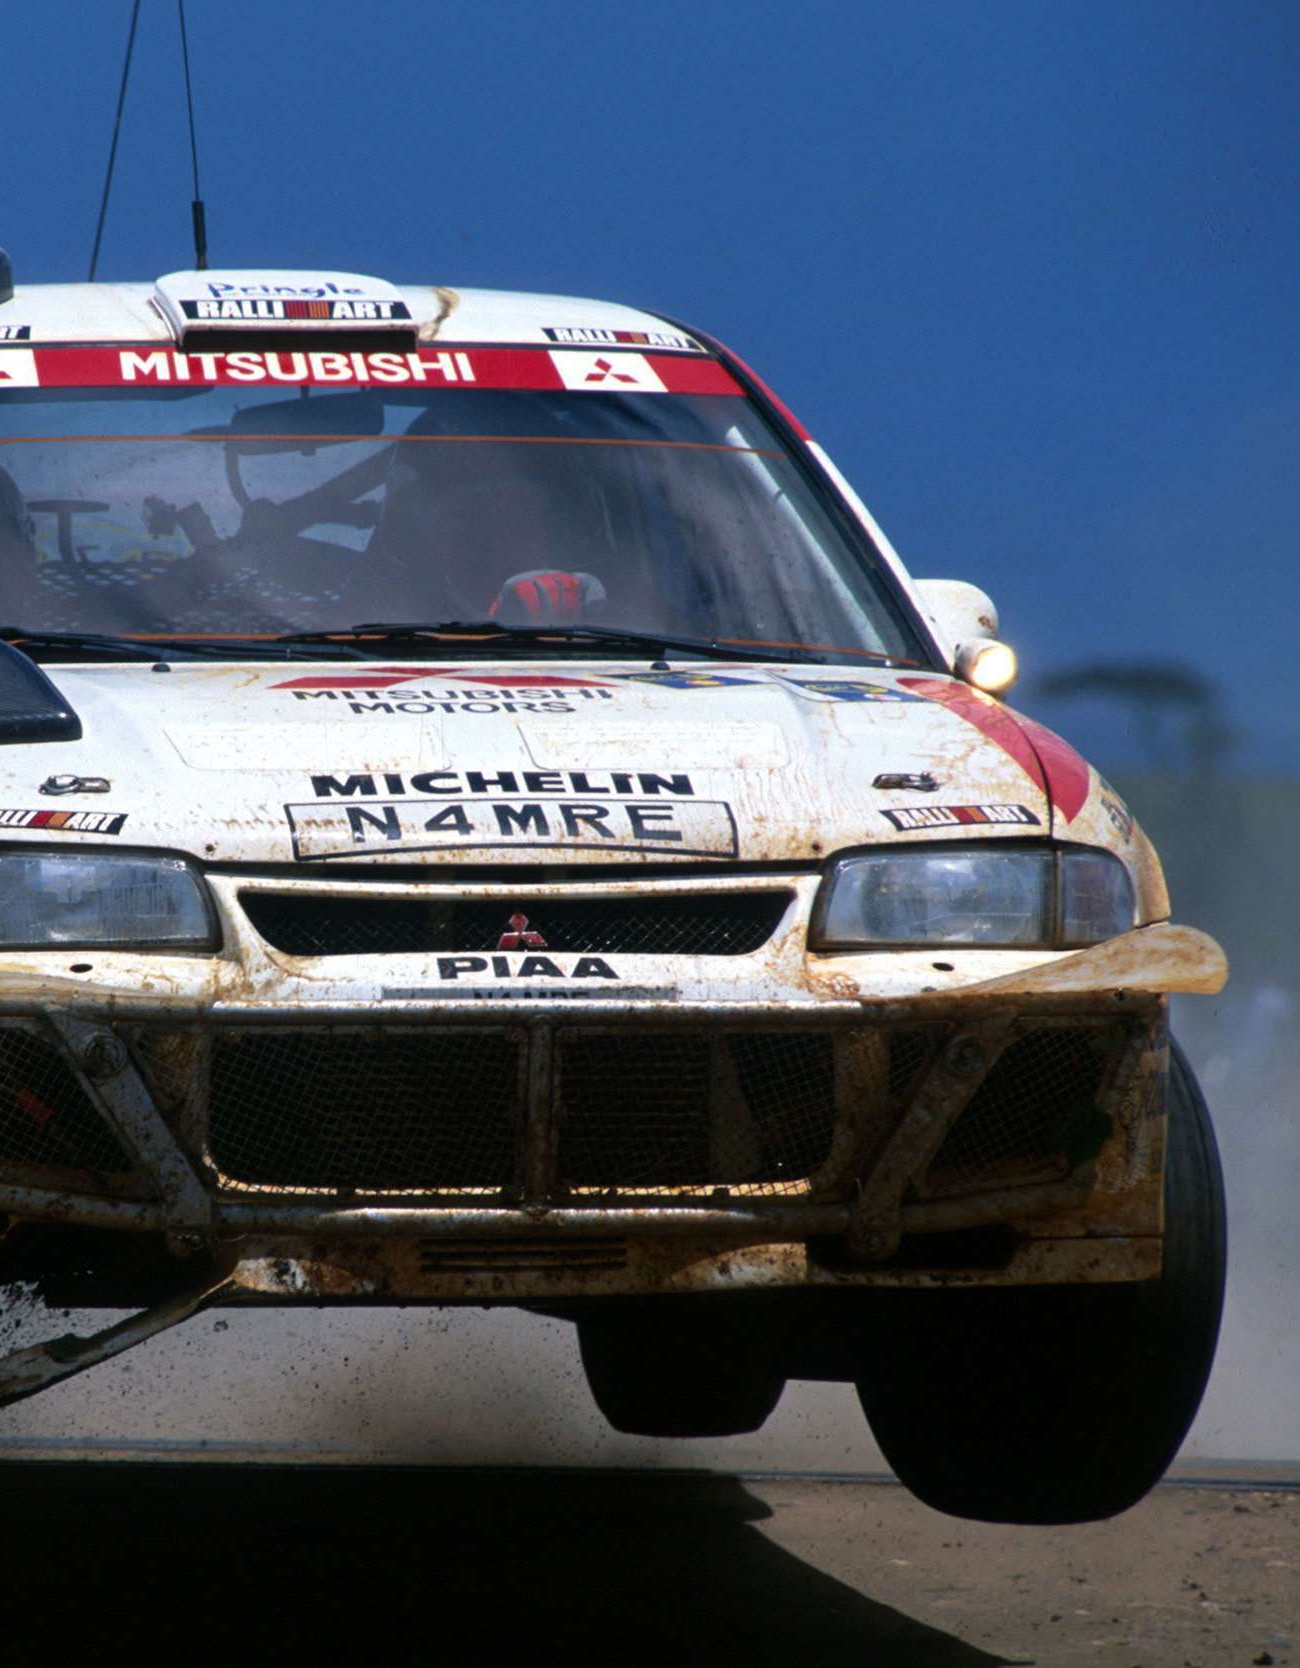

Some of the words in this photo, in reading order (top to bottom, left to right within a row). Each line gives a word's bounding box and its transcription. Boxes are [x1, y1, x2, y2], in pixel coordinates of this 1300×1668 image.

[206, 281, 366, 299] Pringle
[196, 300, 286, 319] RALLI
[331, 300, 394, 319] ART
[553, 329, 617, 342] RALLI
[646, 333, 689, 348] ART
[119, 350, 477, 383] MITSUBISHI
[291, 688, 614, 701] MITSUBISHI
[349, 701, 576, 715] MOTORS
[308, 771, 695, 798] MICHELIN
[61, 813, 121, 833] ART
[891, 808, 960, 829] RALLI
[979, 804, 1029, 824] ART
[436, 955, 621, 980] PIAA
